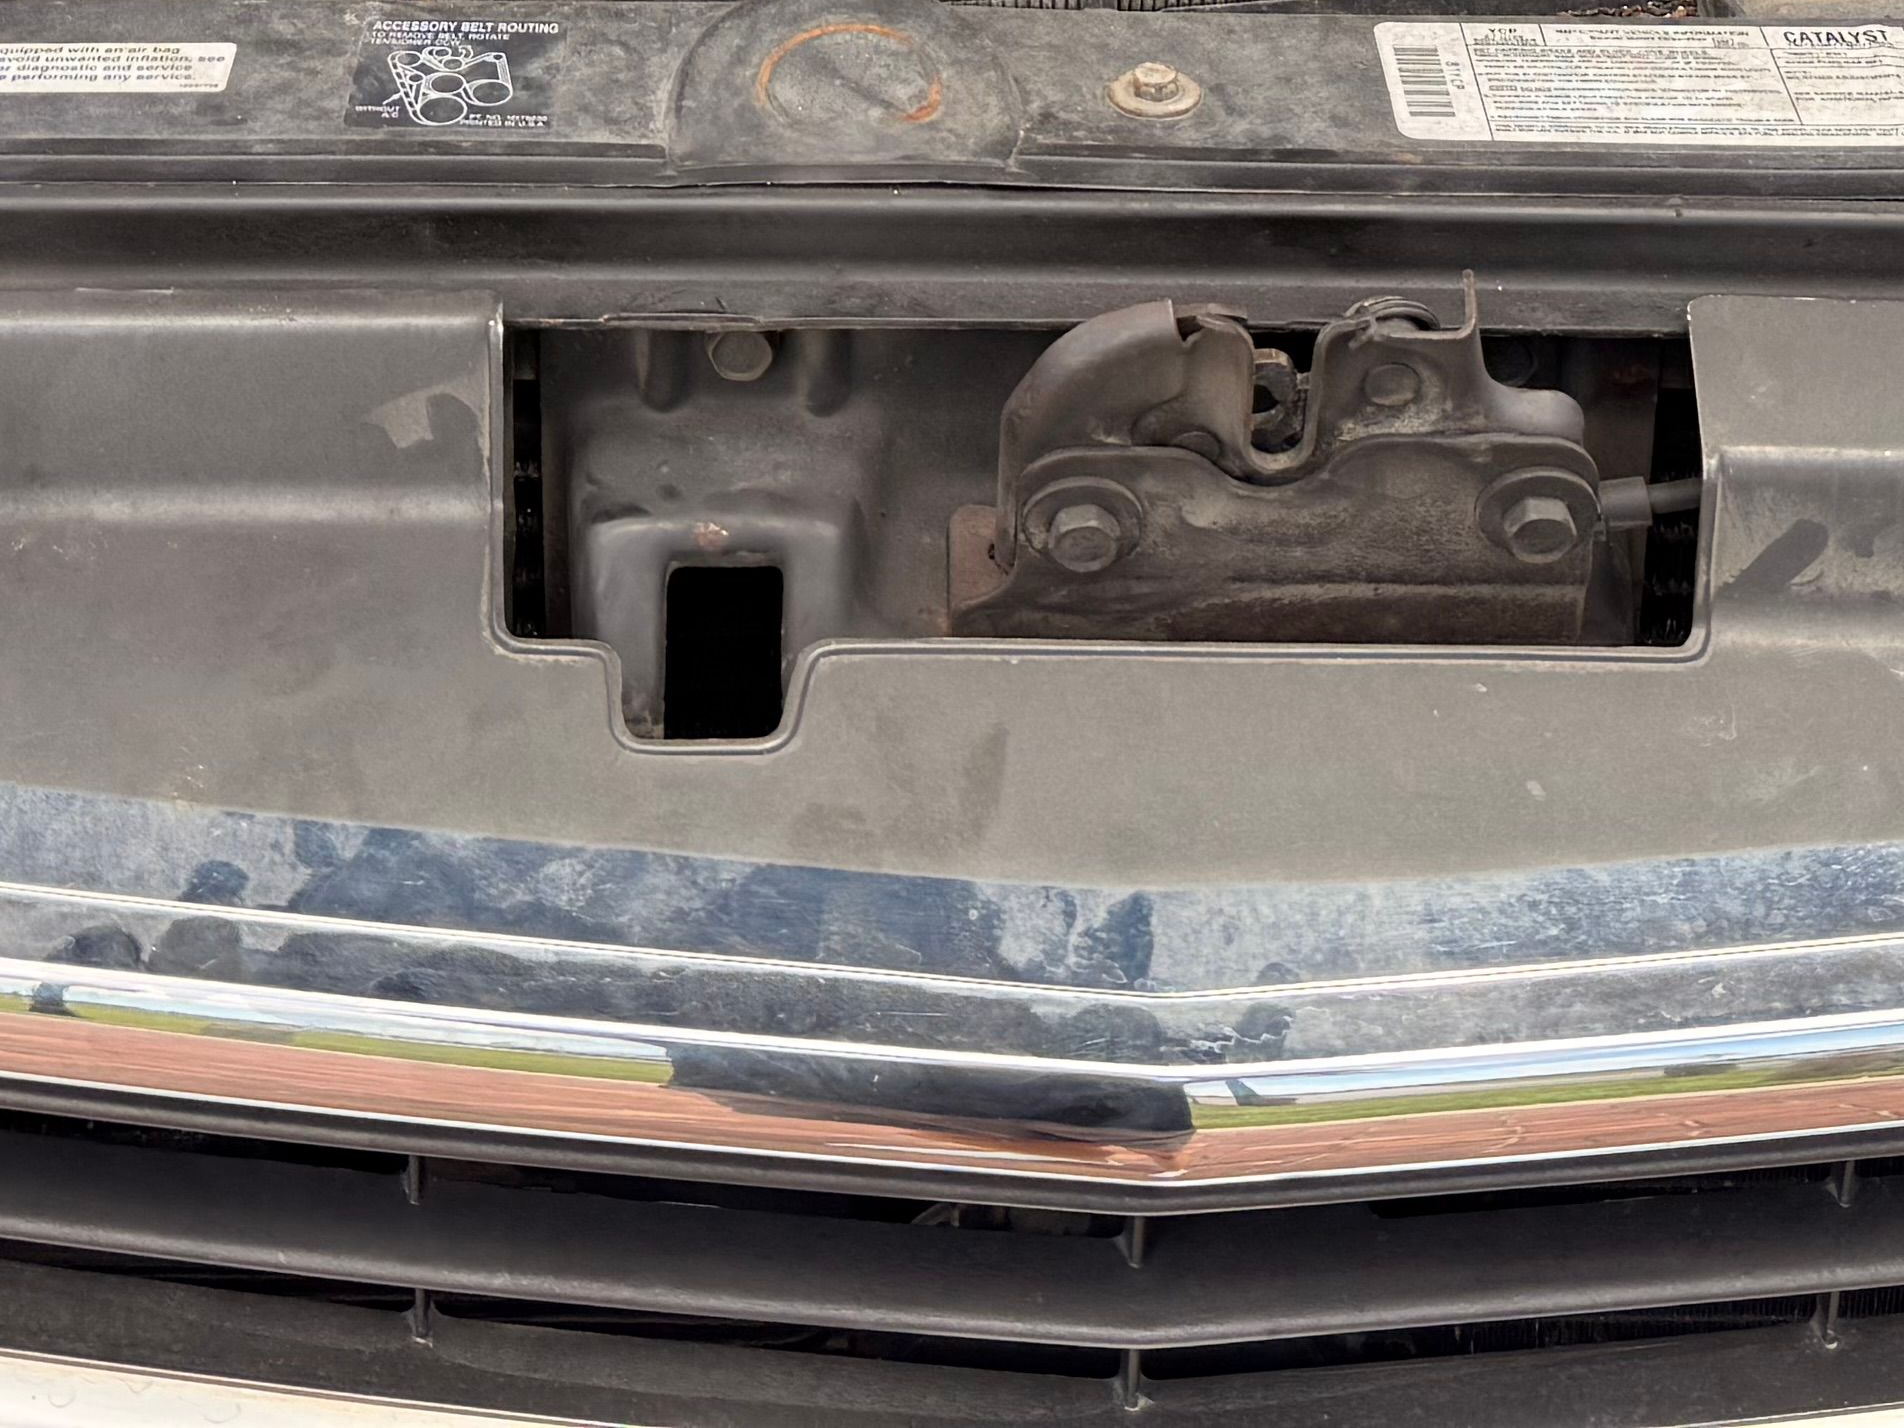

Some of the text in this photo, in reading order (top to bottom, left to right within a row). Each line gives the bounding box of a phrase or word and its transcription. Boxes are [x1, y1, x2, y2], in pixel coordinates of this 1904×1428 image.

[373, 21, 559, 34] ACCESSORY BELT ROUTING
[1783, 29, 1888, 46] CATALYST
[153, 46, 181, 55] bag
[17, 64, 97, 73] diagnostic
[11, 73, 97, 82] performing
[103, 74, 131, 82] any
